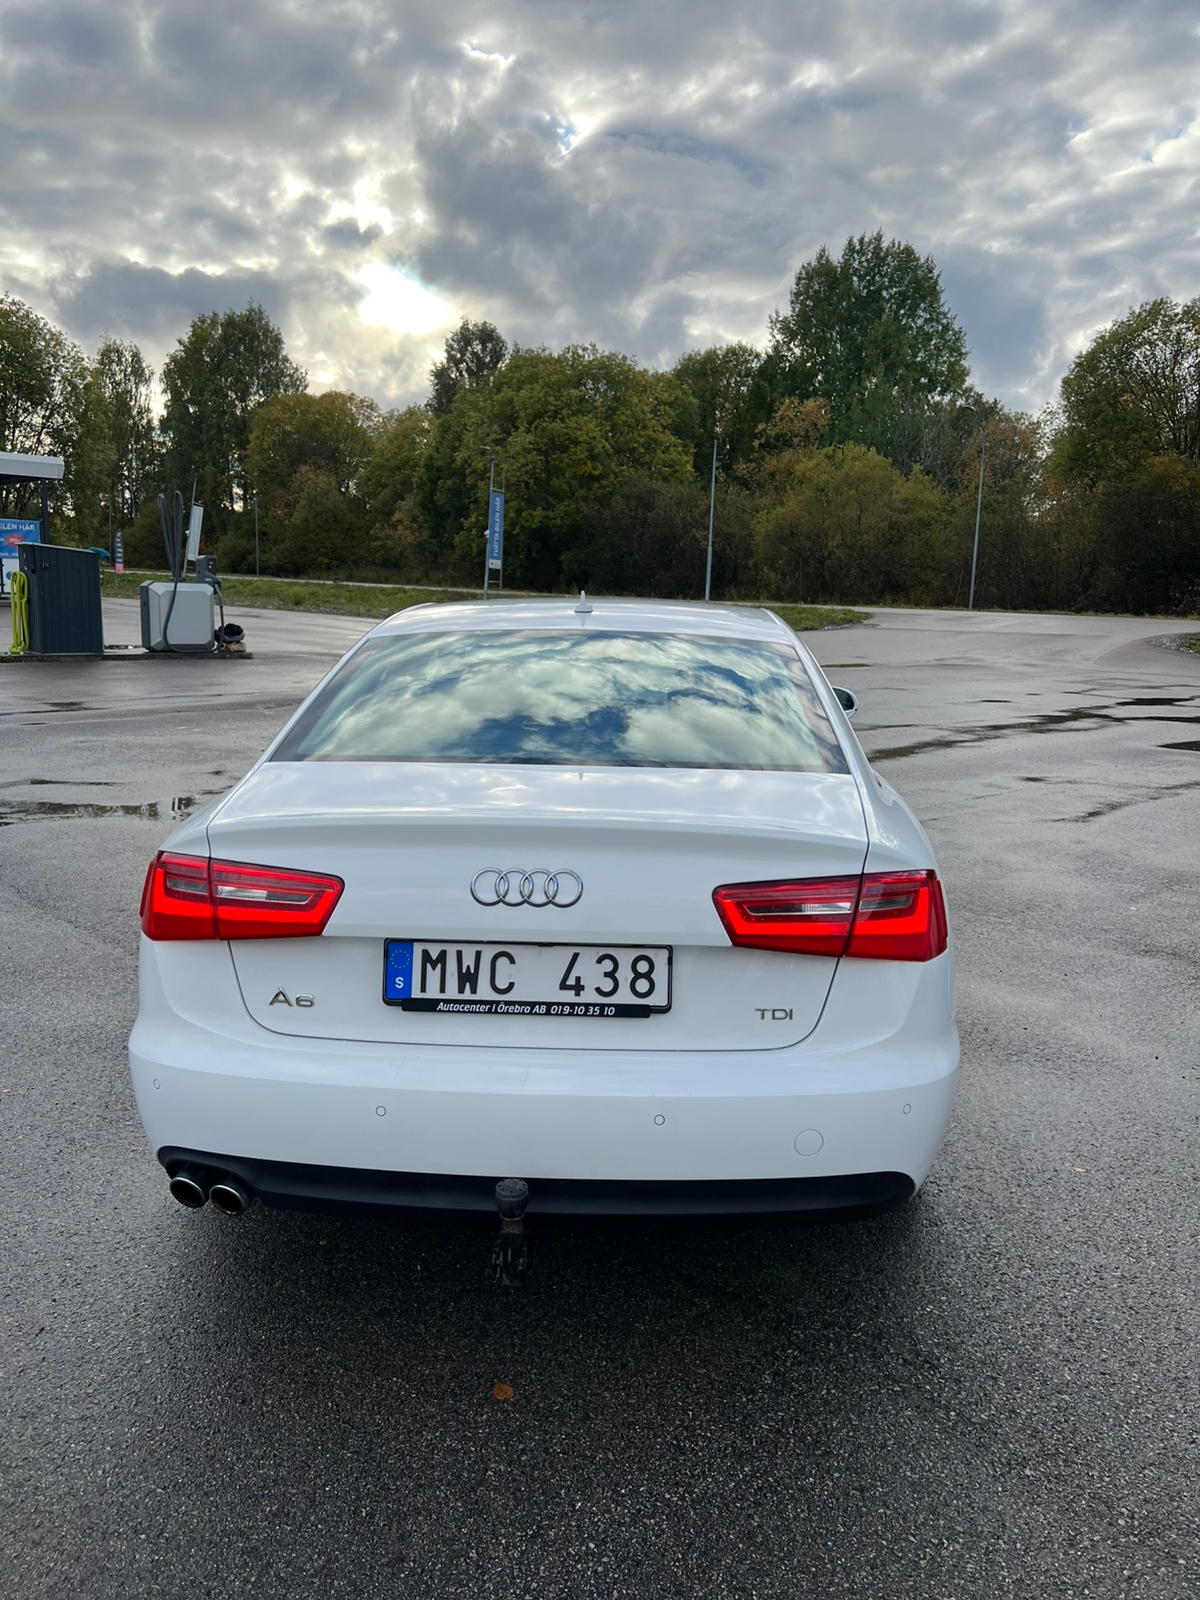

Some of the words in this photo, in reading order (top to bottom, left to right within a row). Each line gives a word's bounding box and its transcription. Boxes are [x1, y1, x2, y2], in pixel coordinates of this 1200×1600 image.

[420, 949, 516, 995] MWC
[558, 951, 656, 999] 438
[395, 976, 404, 989] S
[268, 986, 315, 1008] A6
[436, 1001, 490, 1013] Autocenter
[497, 1001, 531, 1014] Örebro
[532, 1004, 547, 1014] AB
[550, 1005, 586, 1015] 019-10
[587, 1006, 600, 1016] 35
[603, 1006, 616, 1016] 10
[754, 1008, 793, 1020] TDI
